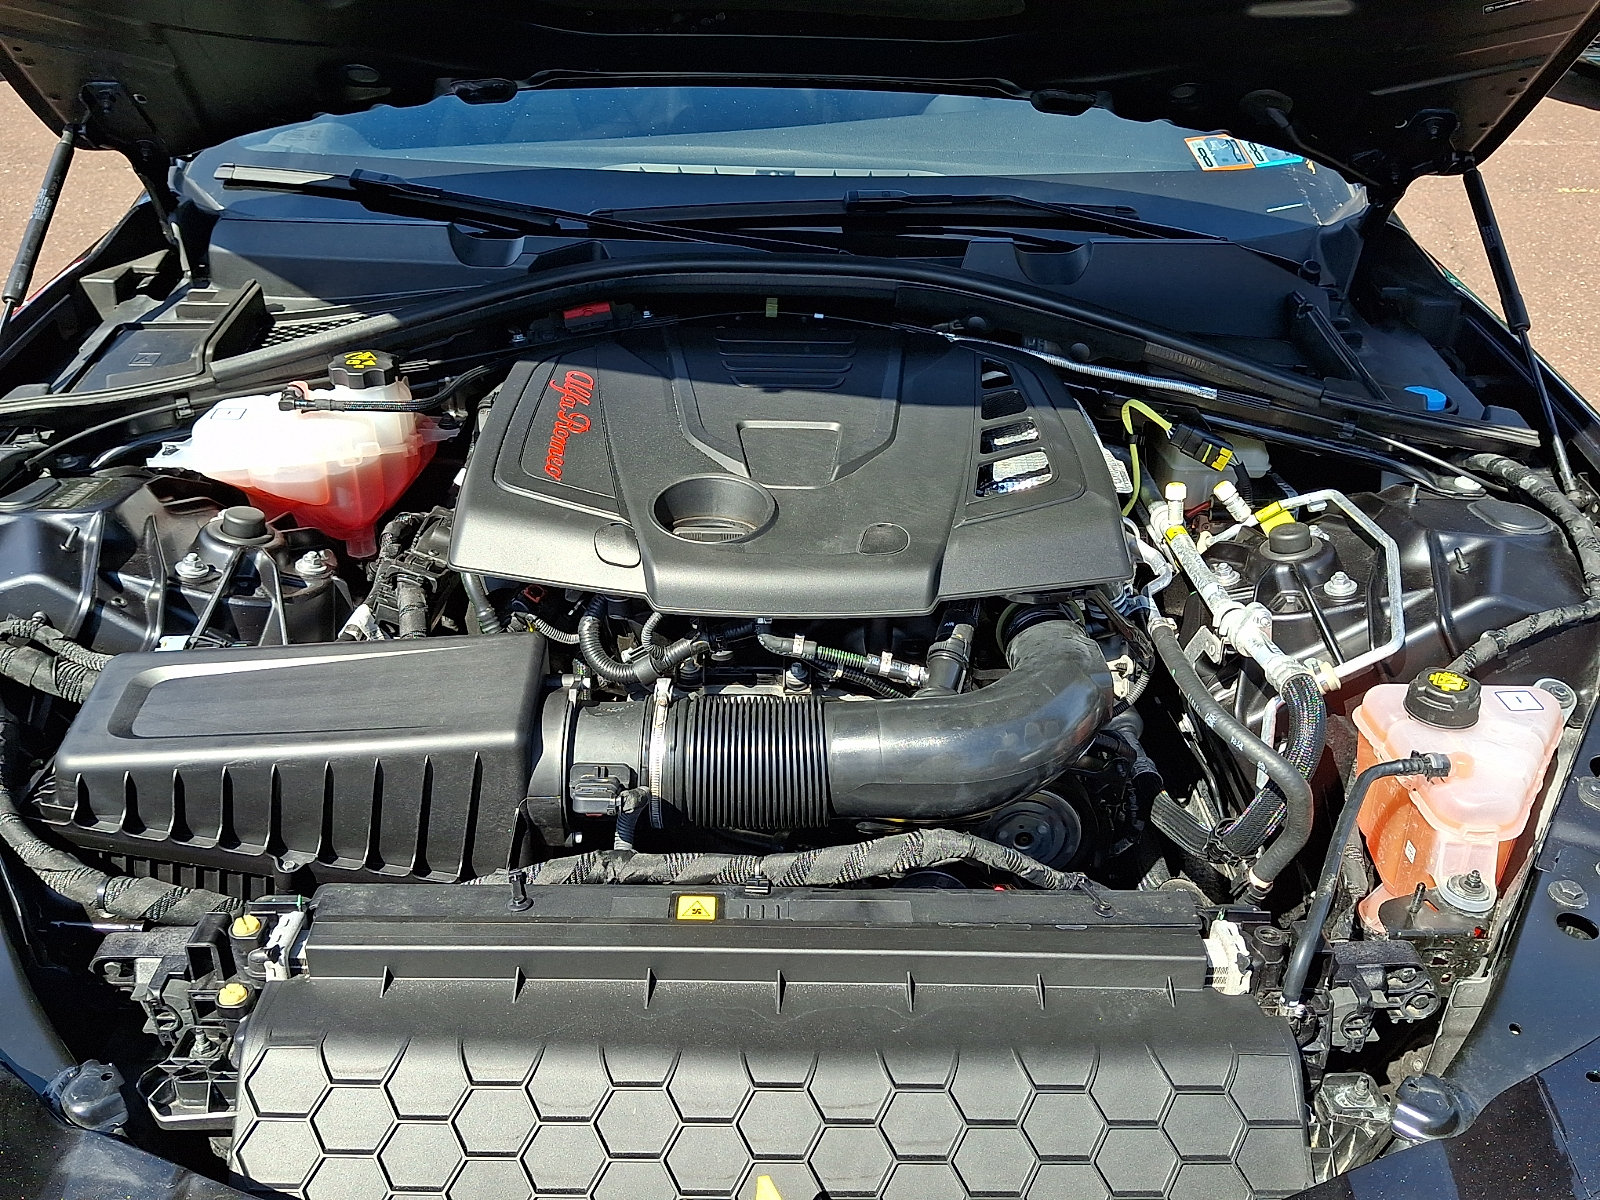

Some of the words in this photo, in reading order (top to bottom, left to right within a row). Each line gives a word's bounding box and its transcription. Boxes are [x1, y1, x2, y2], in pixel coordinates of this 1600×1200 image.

[1197, 147, 1213, 168] 8
[549, 370, 594, 411] Alfa
[544, 410, 591, 481] Romeo
